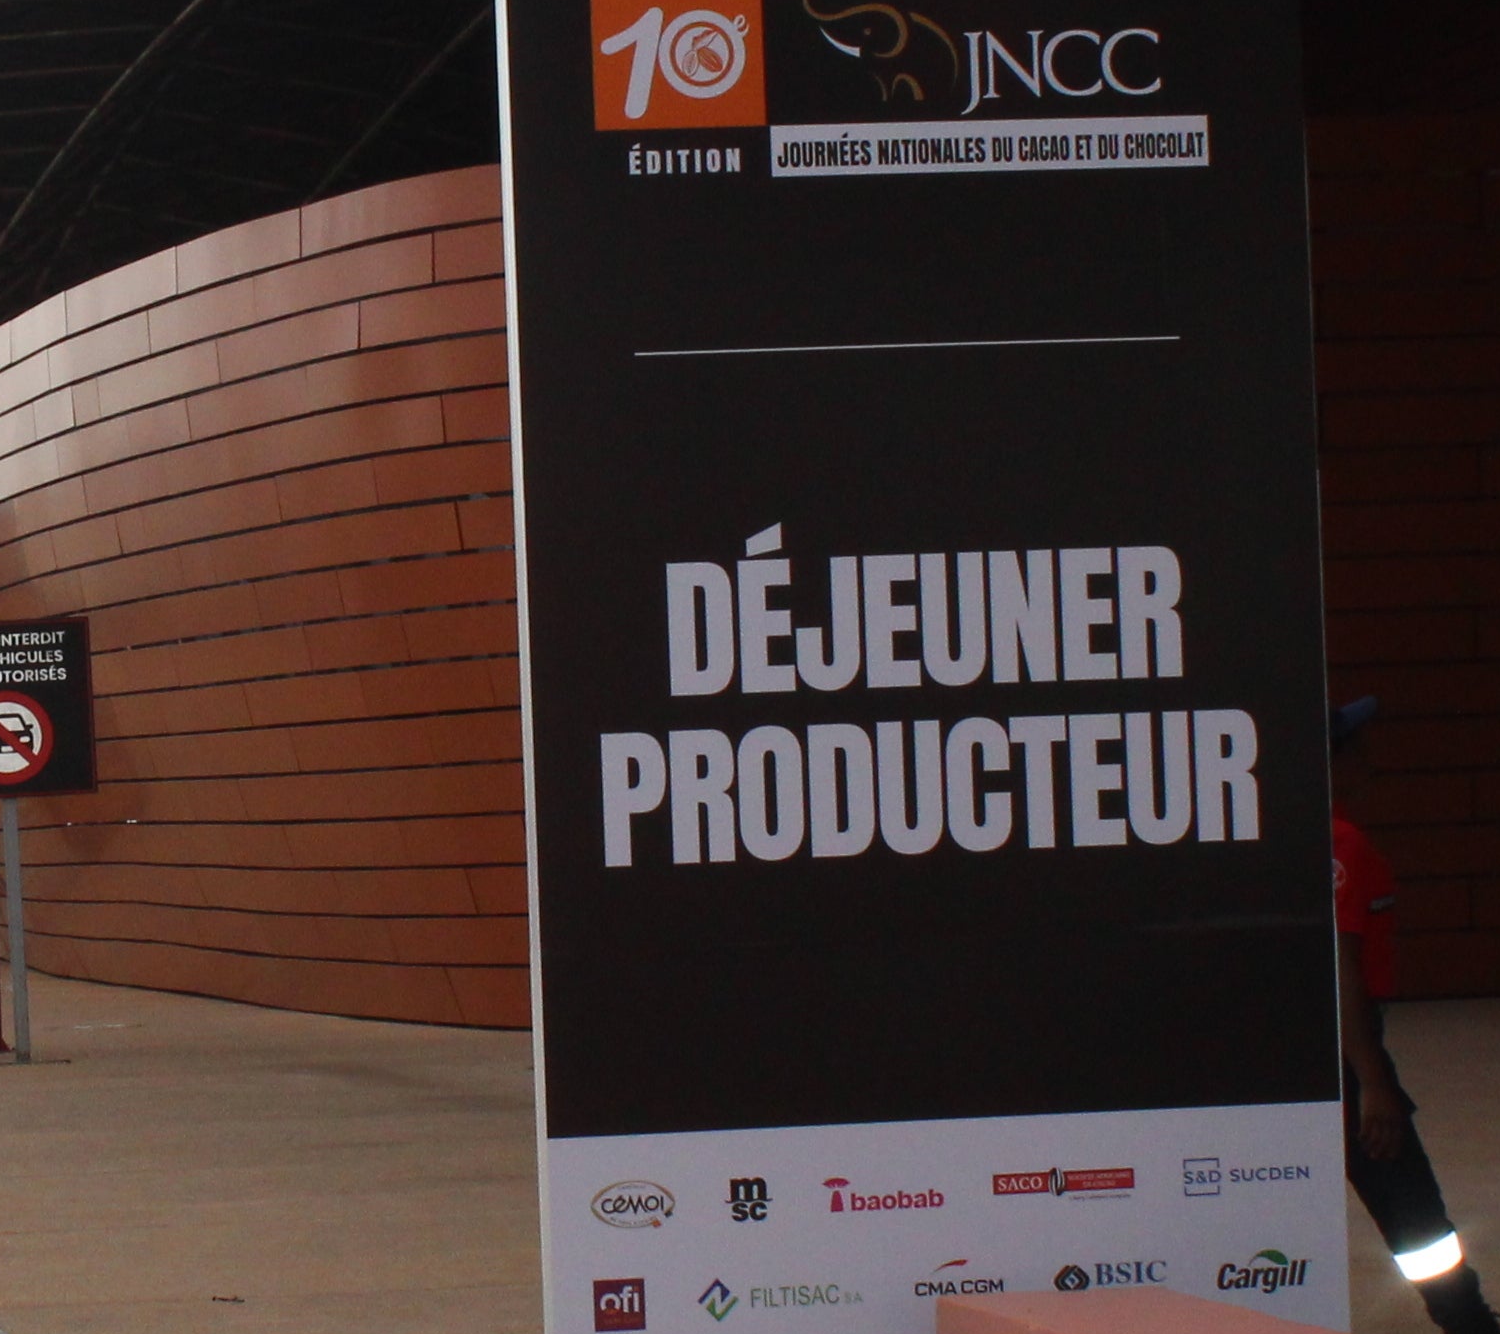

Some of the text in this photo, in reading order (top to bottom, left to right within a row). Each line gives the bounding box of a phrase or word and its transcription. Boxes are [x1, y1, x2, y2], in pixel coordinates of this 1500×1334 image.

[961, 28, 1161, 115] JNCC
[629, 143, 741, 175] ÉDITION
[777, 132, 1205, 167] JOURNÉES NATIONALES DU CACAO ET DU CHOCOLAT
[665, 522, 1183, 697] DÉJEUNER
[600, 709, 1260, 867] PRODUCTEUR
[998, 1176, 1043, 1191] SACO
[1184, 1166, 1310, 1184] S&D SUCDEN
[850, 1189, 944, 1211] baobab
[1094, 1260, 1168, 1285] BSIC
[1217, 1259, 1307, 1294] Cargill
[600, 1285, 640, 1312] ofi
[750, 1284, 840, 1308] FILTISAC
[914, 1279, 1004, 1296] CMA CGM
